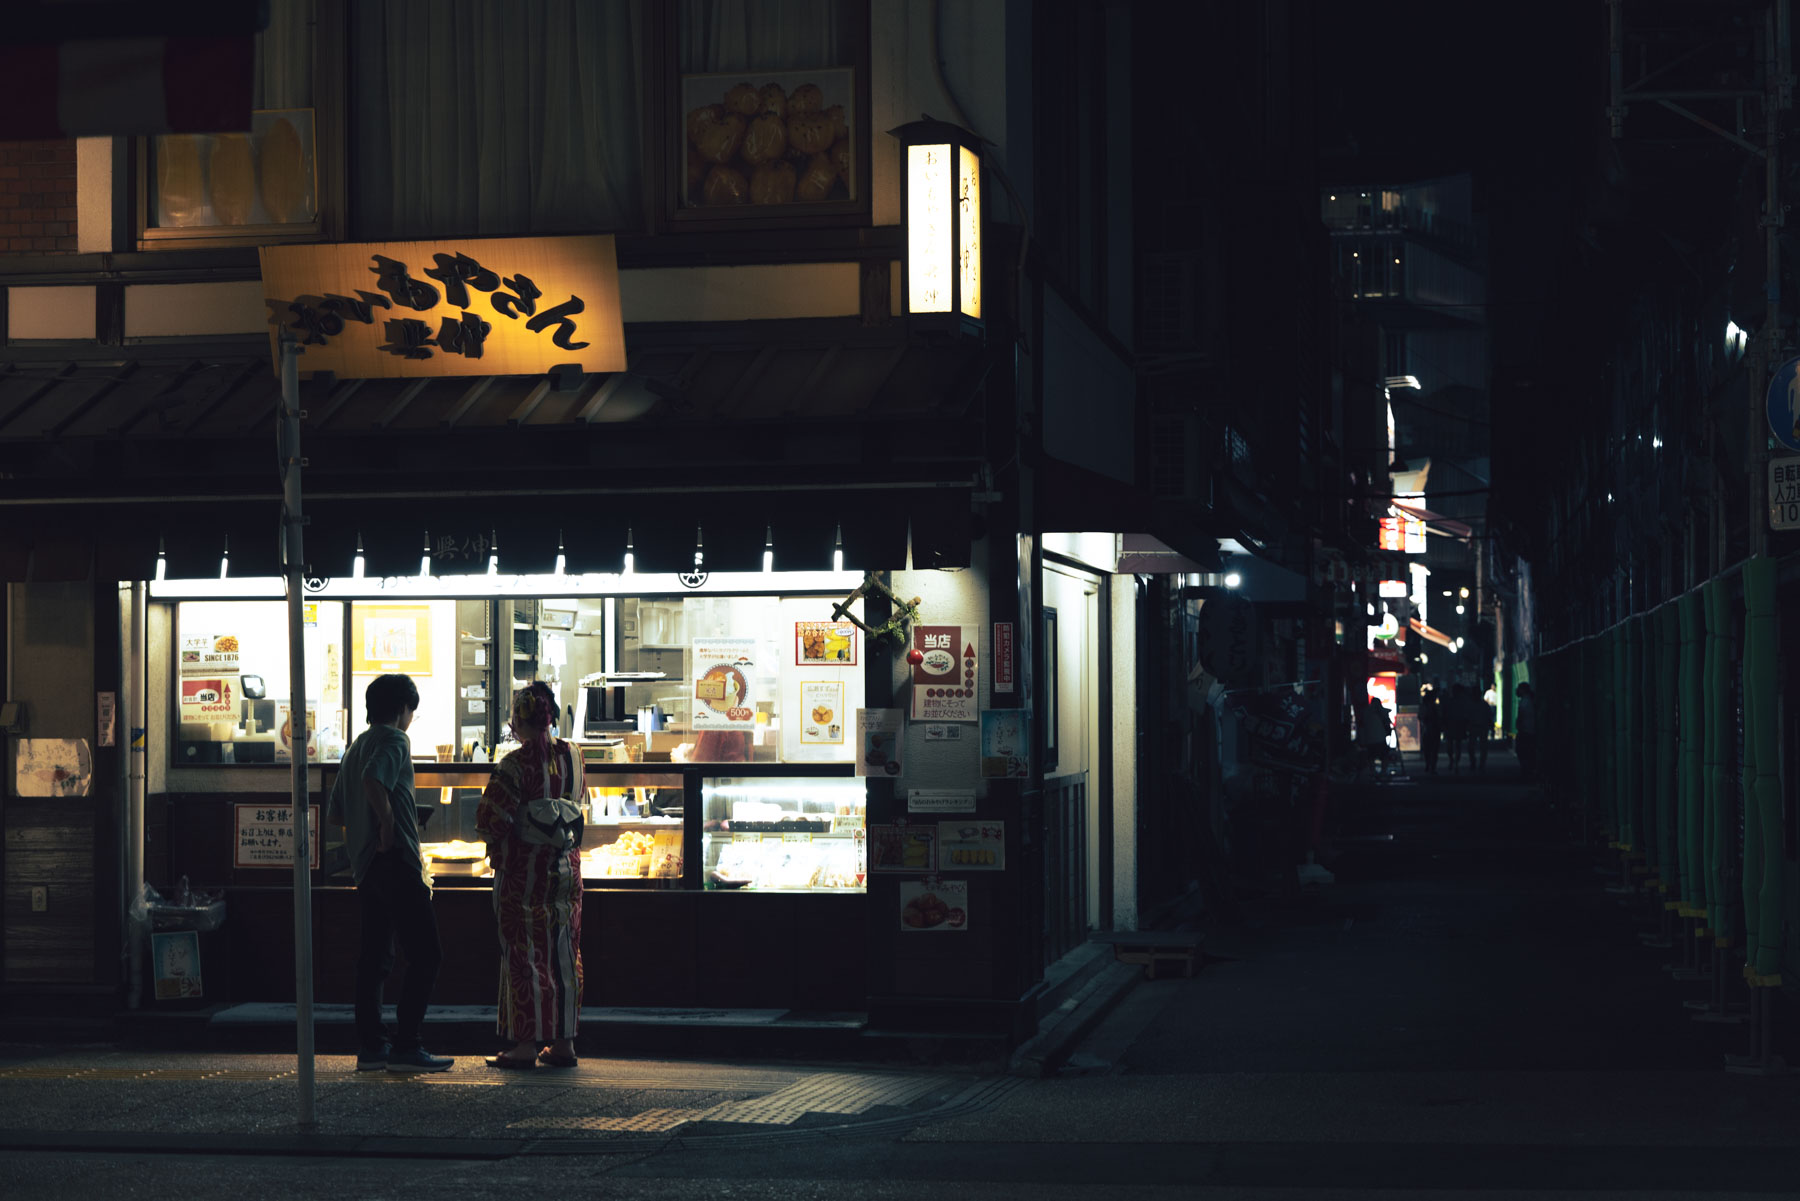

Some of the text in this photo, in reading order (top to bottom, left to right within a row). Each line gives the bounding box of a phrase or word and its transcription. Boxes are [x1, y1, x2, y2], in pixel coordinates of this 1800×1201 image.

[924, 633, 952, 649] 当店
[204, 653, 239, 662] SINCE 1876
[200, 692, 216, 702] 当店
[923, 699, 966, 708] 建物にそって
[923, 709, 970, 718] お並びください
[255, 808, 293, 823] お客様
